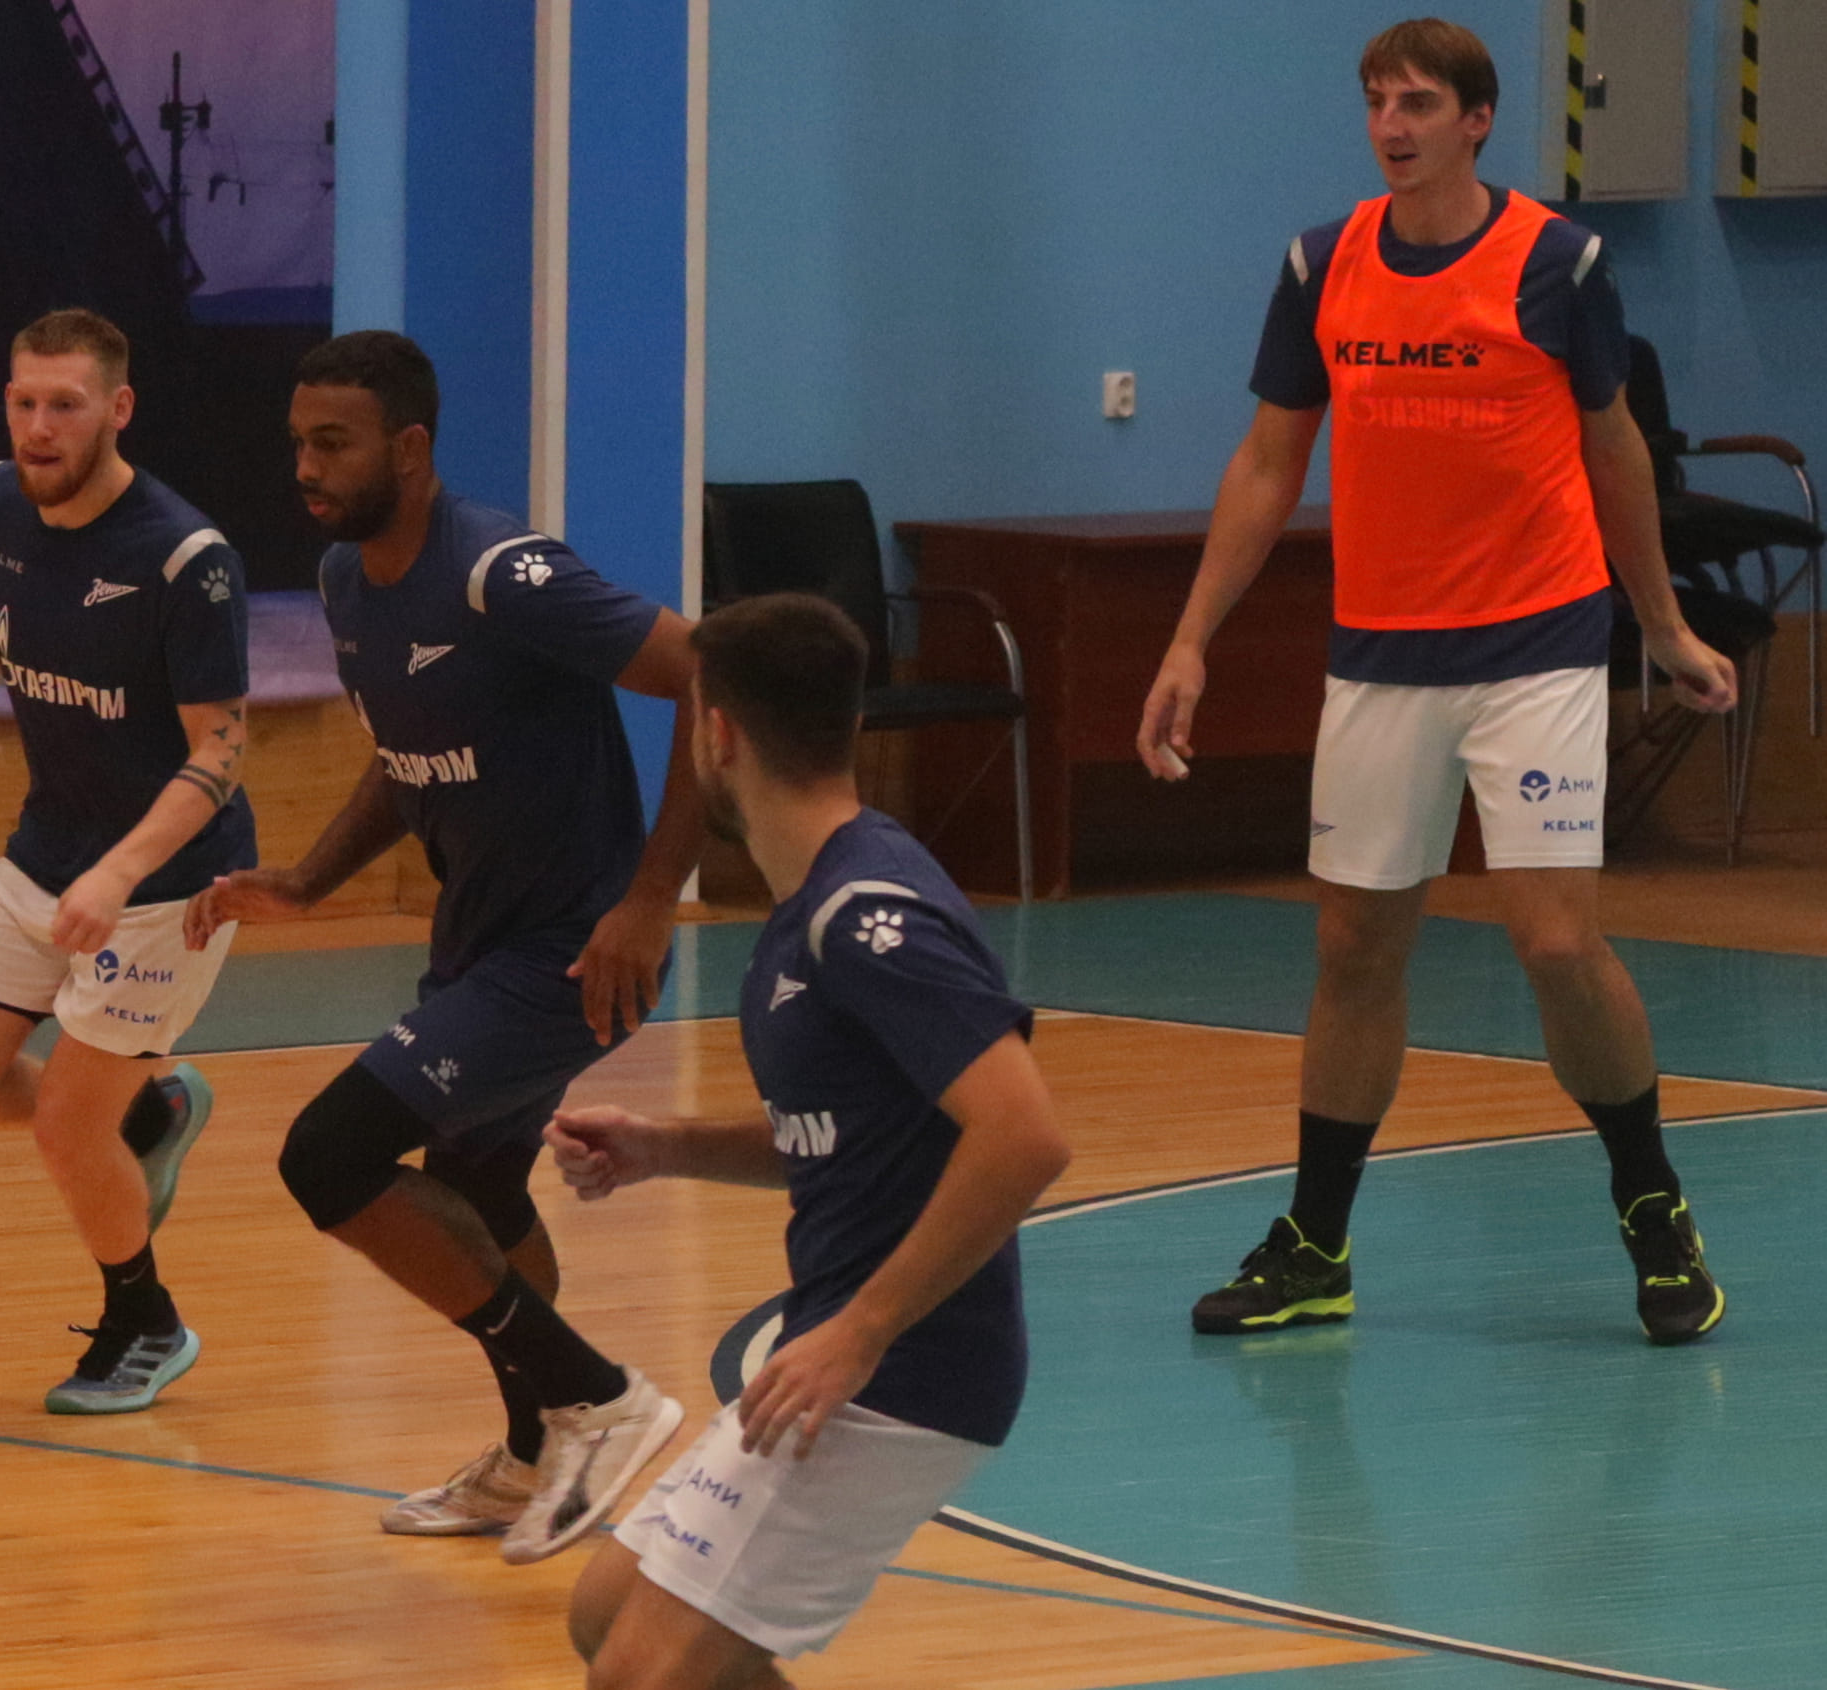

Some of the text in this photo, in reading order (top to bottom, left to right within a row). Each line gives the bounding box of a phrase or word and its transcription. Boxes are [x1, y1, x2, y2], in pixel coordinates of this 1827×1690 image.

[1335, 341, 1453, 368] KELME
[1543, 820, 1596, 832] KELME
[105, 1005, 163, 1024] KELM
